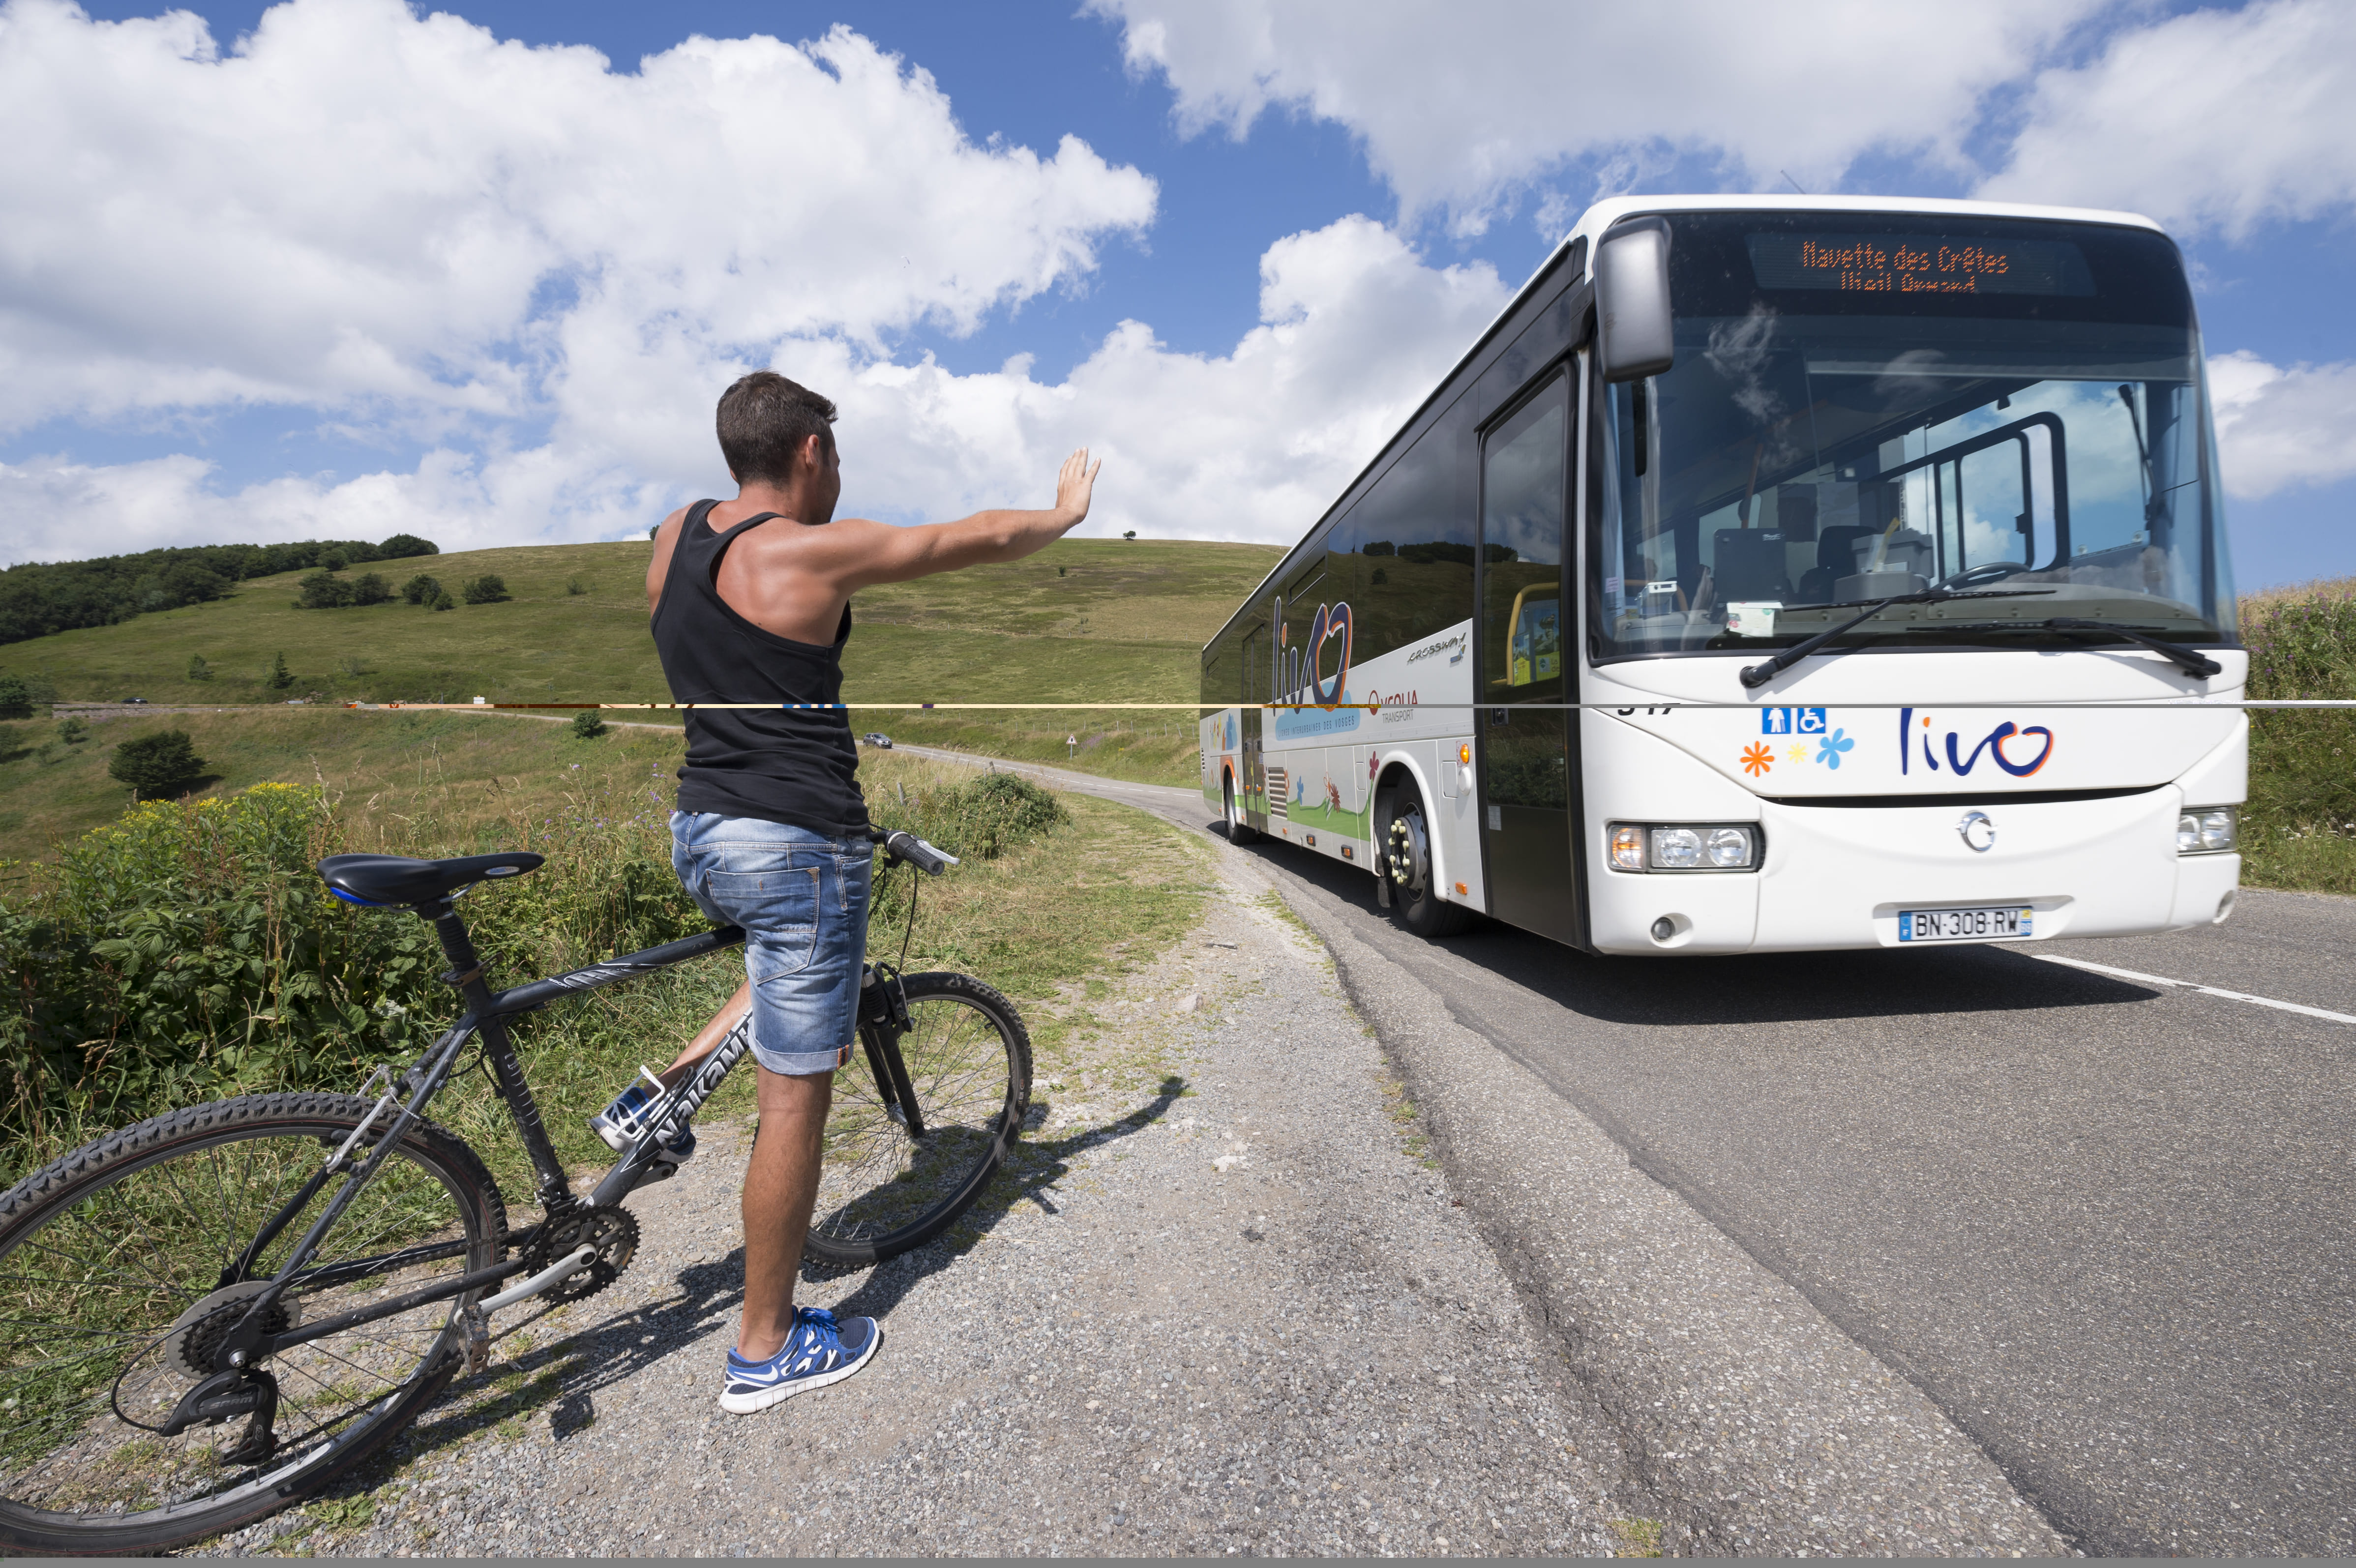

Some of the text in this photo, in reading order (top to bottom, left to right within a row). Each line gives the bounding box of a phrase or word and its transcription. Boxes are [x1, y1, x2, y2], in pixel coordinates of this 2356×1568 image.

[1803, 240, 1886, 269] Navette
[1894, 244, 1931, 270] des
[1407, 631, 1466, 663] CROSSWAY
[1291, 722, 1321, 735] INTERURBAINES
[1323, 720, 1332, 730] DES
[1335, 715, 1355, 728] VOSGES
[1382, 709, 1414, 724] TRANSPORT
[1900, 708, 2054, 777] livo
[1916, 910, 2018, 936] BN-308-RW
